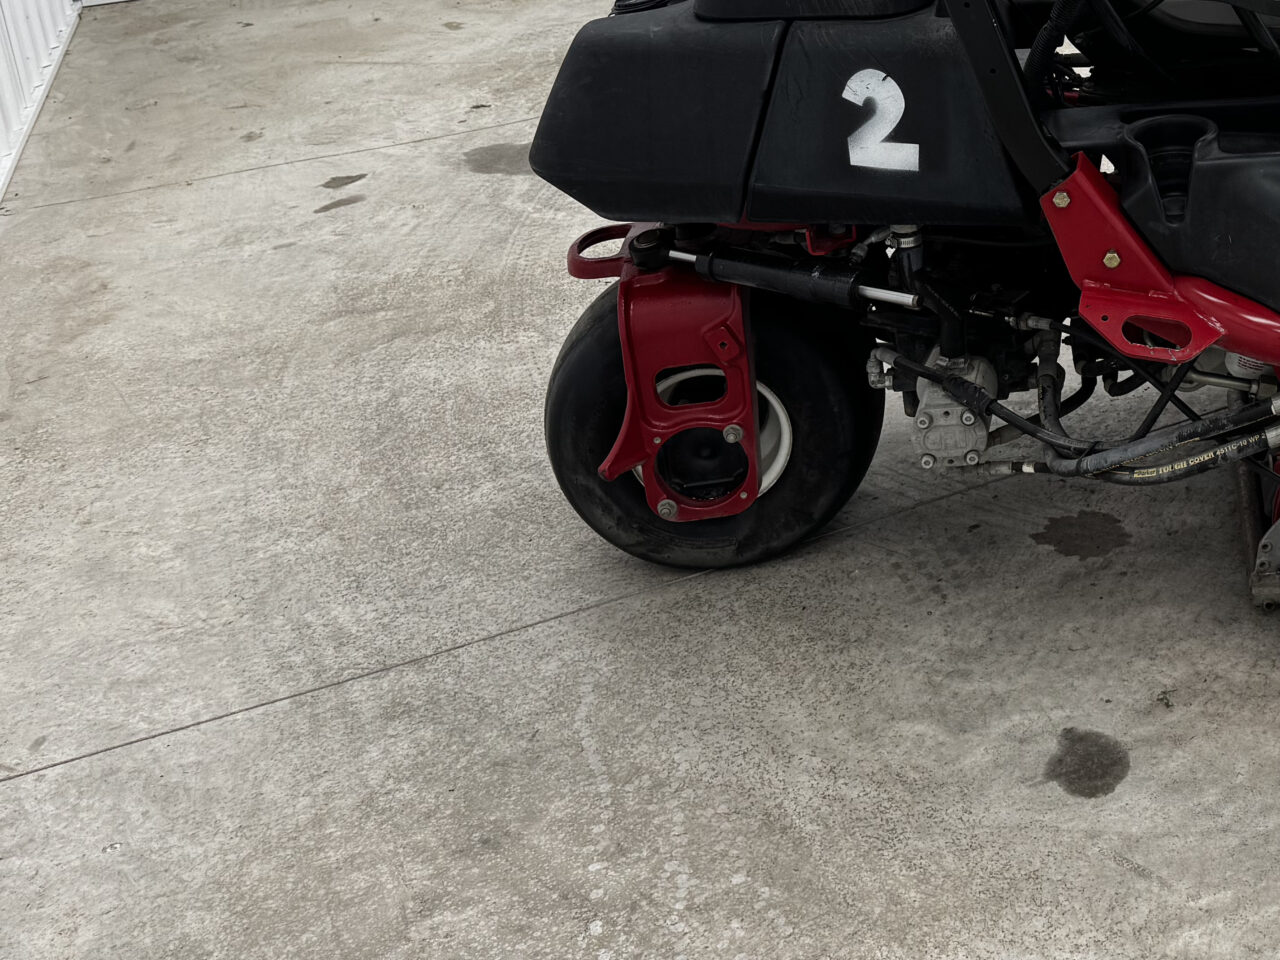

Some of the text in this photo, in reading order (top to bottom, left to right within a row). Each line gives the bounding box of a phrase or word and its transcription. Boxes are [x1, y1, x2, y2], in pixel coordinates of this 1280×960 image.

[841, 68, 920, 172] 2
[1159, 460, 1187, 474] TOUGH
[1188, 451, 1215, 466] COVER
